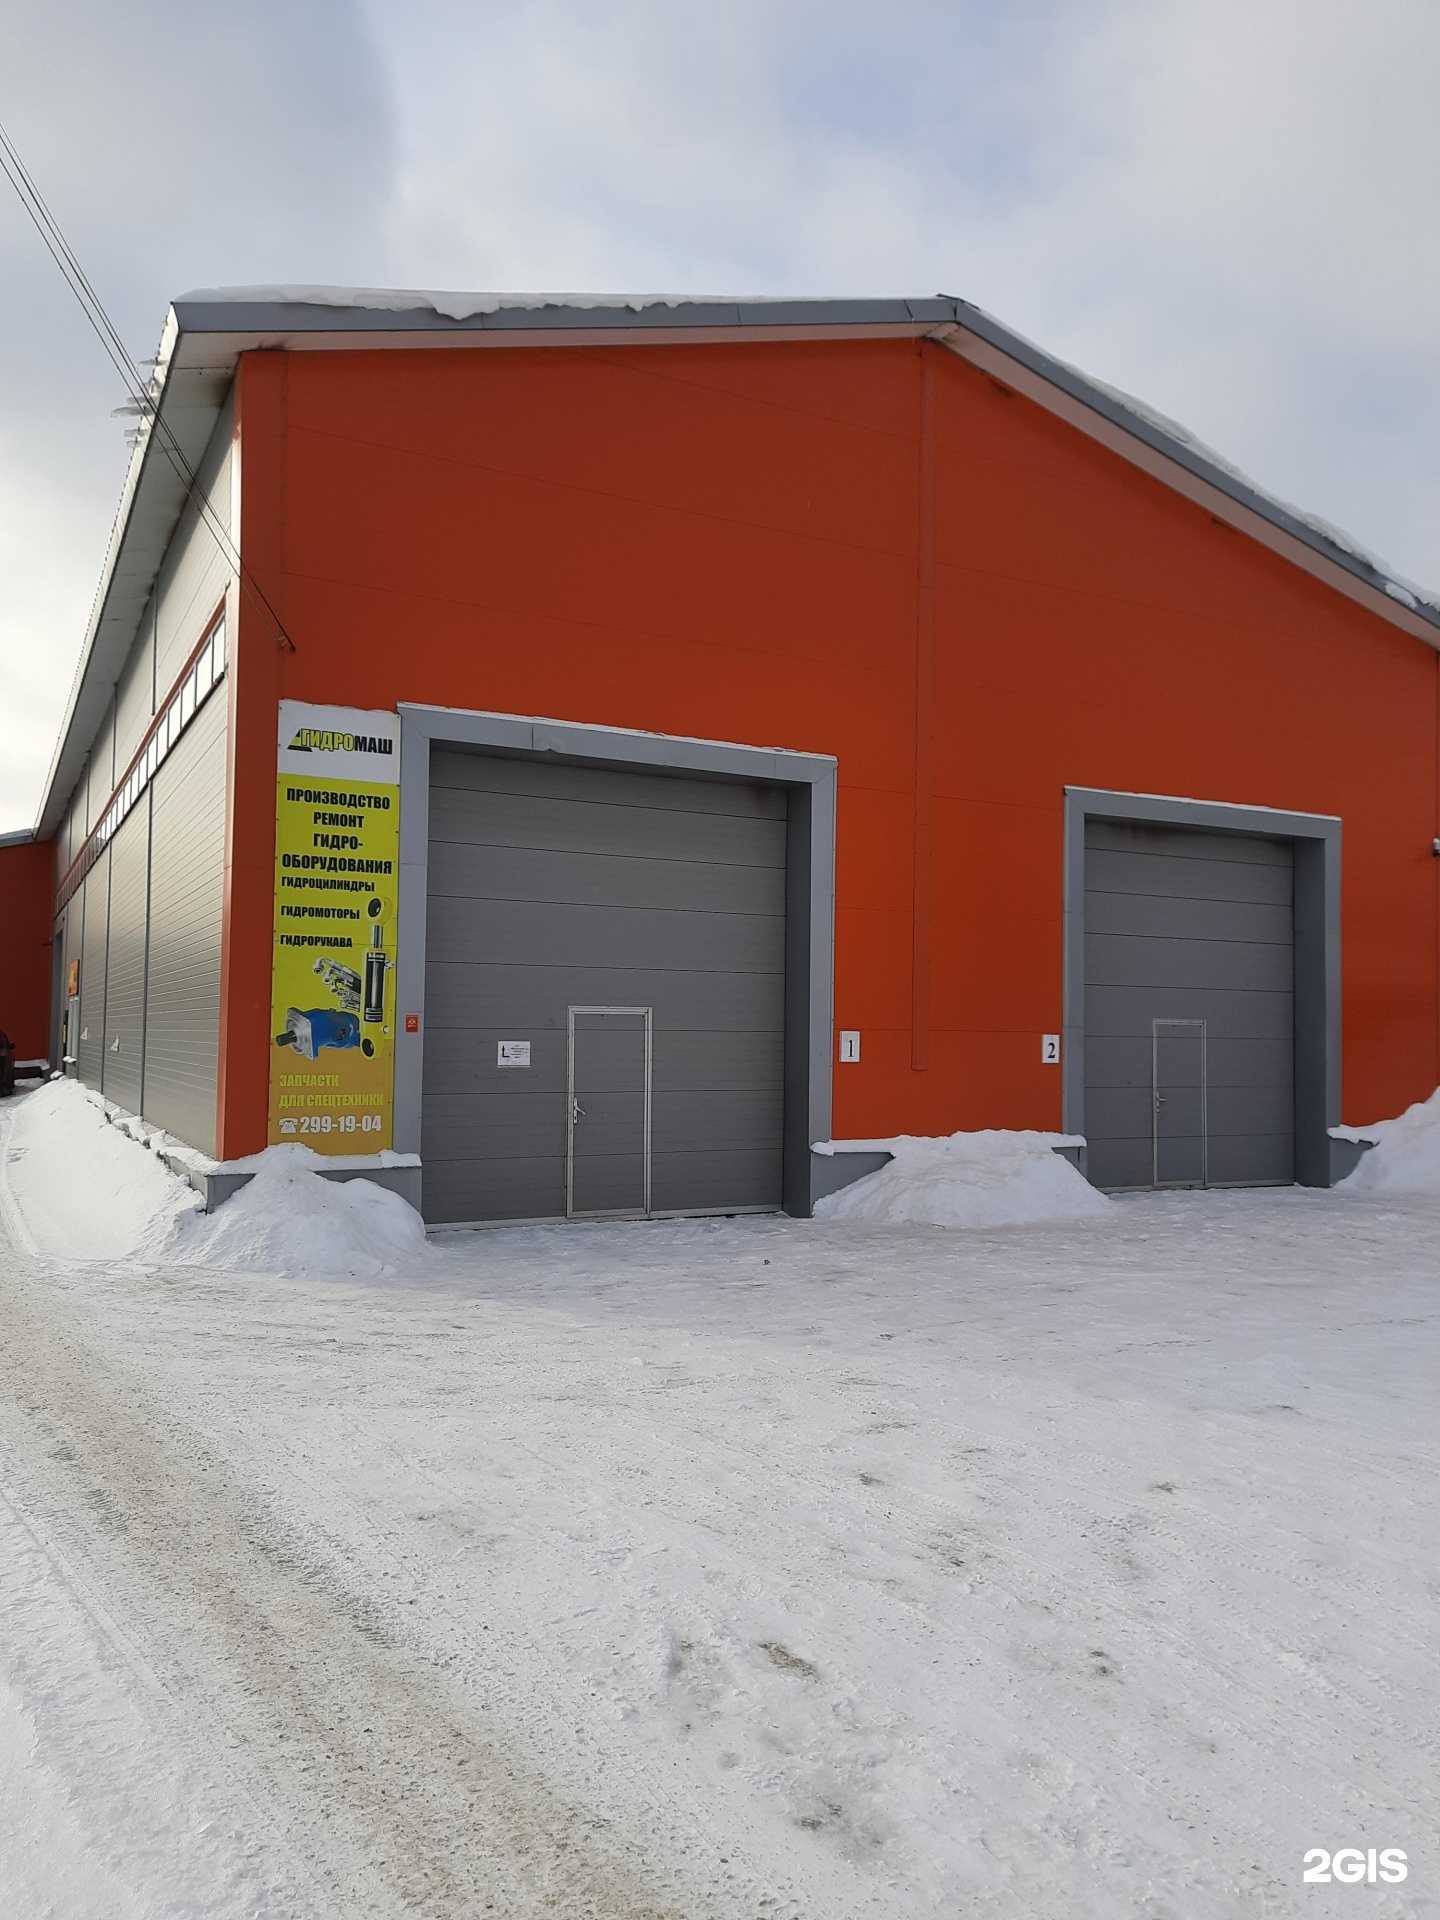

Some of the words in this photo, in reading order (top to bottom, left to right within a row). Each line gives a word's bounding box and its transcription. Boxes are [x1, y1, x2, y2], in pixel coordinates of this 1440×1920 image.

[300, 728, 393, 755] ГИДРОМАШ
[286, 788, 391, 810] ПРОИЗВОДСТВО
[313, 812, 365, 828] РЕМОНТ
[313, 833, 364, 850] ГИДРО-
[282, 853, 393, 875] ОБОРУДОВАНИЯ
[281, 876, 375, 892] ГИДРОЦИЛИНДРЫ
[280, 905, 360, 920] ГИДРОМОТОРЫ
[280, 934, 353, 948] ГИДРОРУКАВА
[1047, 1042, 1056, 1059] 2
[279, 1074, 340, 1087] ЗАПЧАСТИ
[278, 1094, 305, 1108] ДЛЯ
[306, 1094, 384, 1108] СПЕЦТЕХНИКИ
[299, 1115, 382, 1134] 299-19-04
